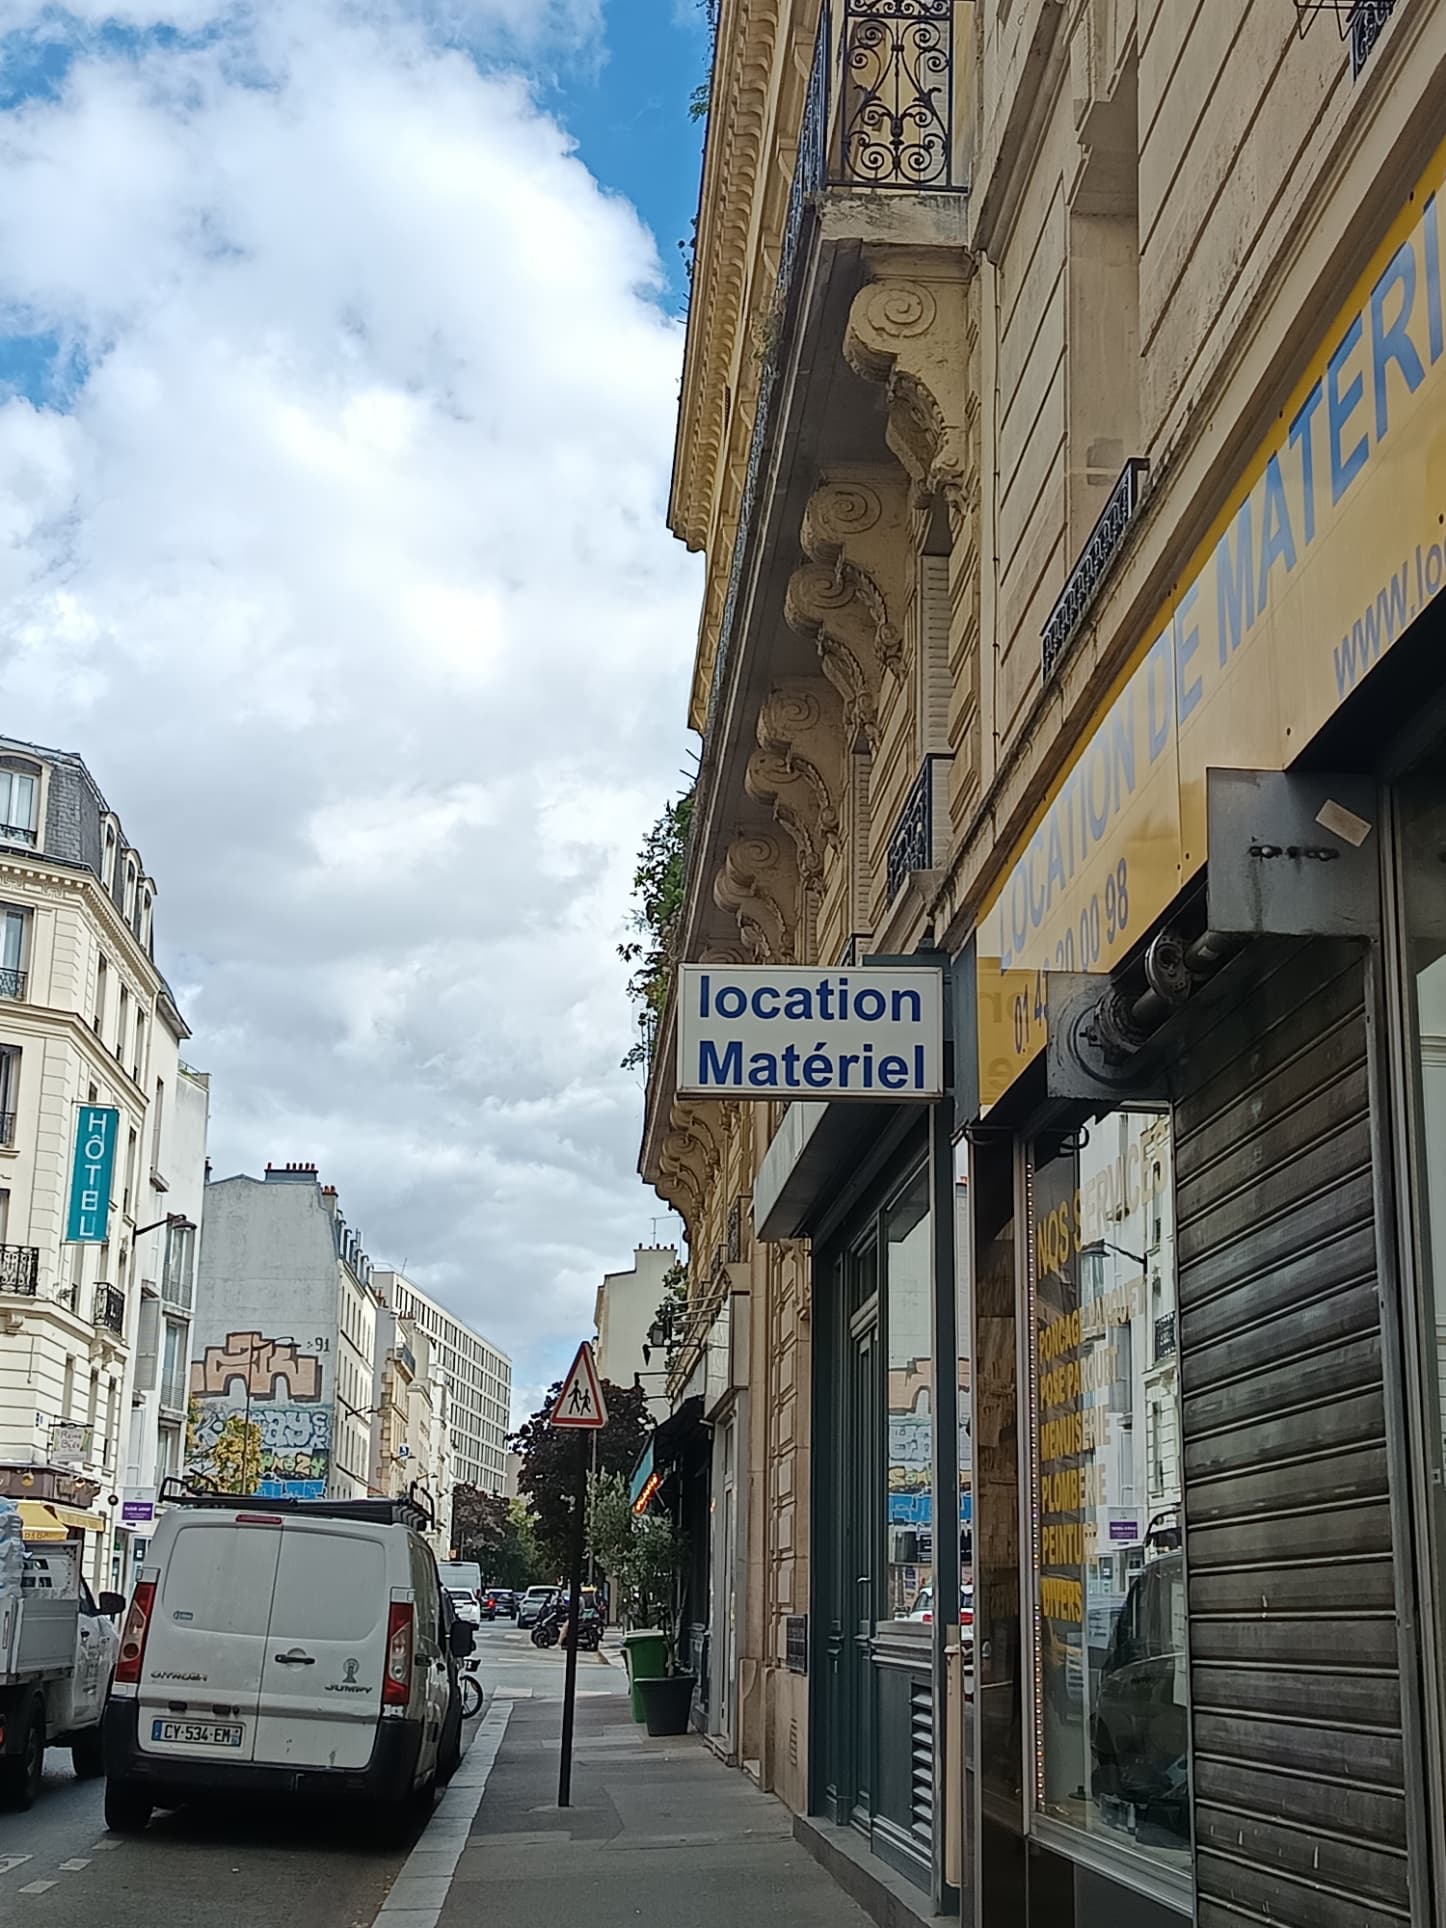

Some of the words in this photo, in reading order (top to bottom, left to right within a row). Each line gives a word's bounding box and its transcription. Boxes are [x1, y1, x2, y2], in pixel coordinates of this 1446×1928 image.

[1333, 536, 1446, 702] www.lo
[1000, 688, 1136, 975] LOCATION
[1147, 578, 1203, 766] DE
[1105, 857, 1129, 944] 98
[699, 975, 921, 1022] location
[699, 1040, 924, 1089] Matériel
[79, 1111, 107, 1237] HÔTEL
[1037, 1200, 1069, 1280] NOS
[1073, 1119, 1168, 1253] SERVICES
[1040, 1364, 1066, 1411] POSE
[1067, 1346, 1120, 1399] PARQUET
[1040, 1404, 1112, 1462] MENUISERIE
[1041, 1464, 1107, 1513] PLOMBERIE
[1041, 1577, 1083, 1622] DIVERS
